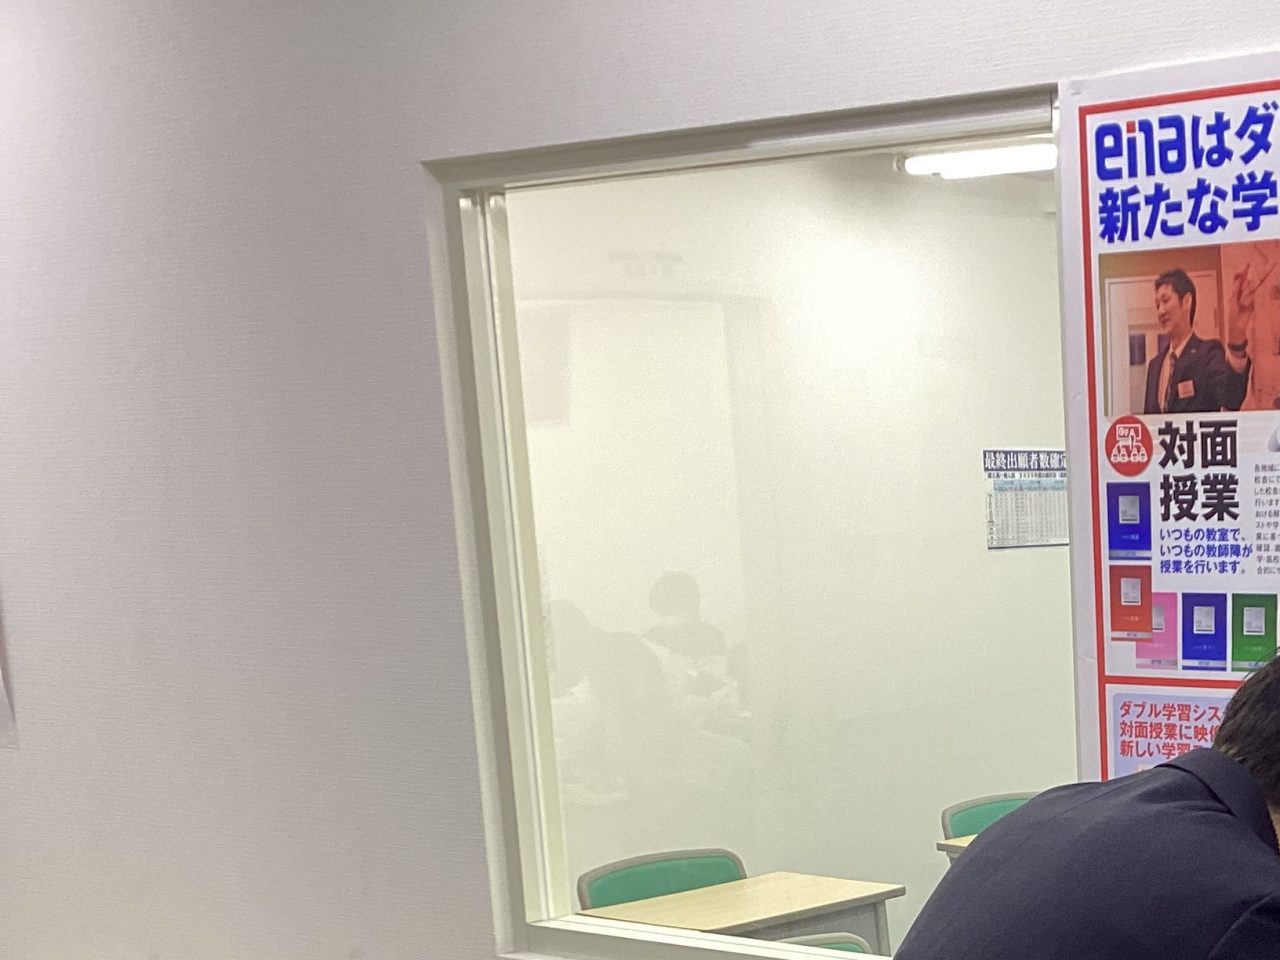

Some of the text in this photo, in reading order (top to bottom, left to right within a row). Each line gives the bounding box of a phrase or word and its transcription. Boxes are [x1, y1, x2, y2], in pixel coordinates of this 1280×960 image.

[1158, 419, 1238, 469] 対面
[1160, 473, 1240, 522] 授業
[1160, 527, 1246, 542] いつもの教室で、
[1160, 543, 1253, 558] いつもの教師陣が
[1160, 560, 1246, 574] 授業を行います。
[1120, 700, 1223, 722] ダブル学習シス
